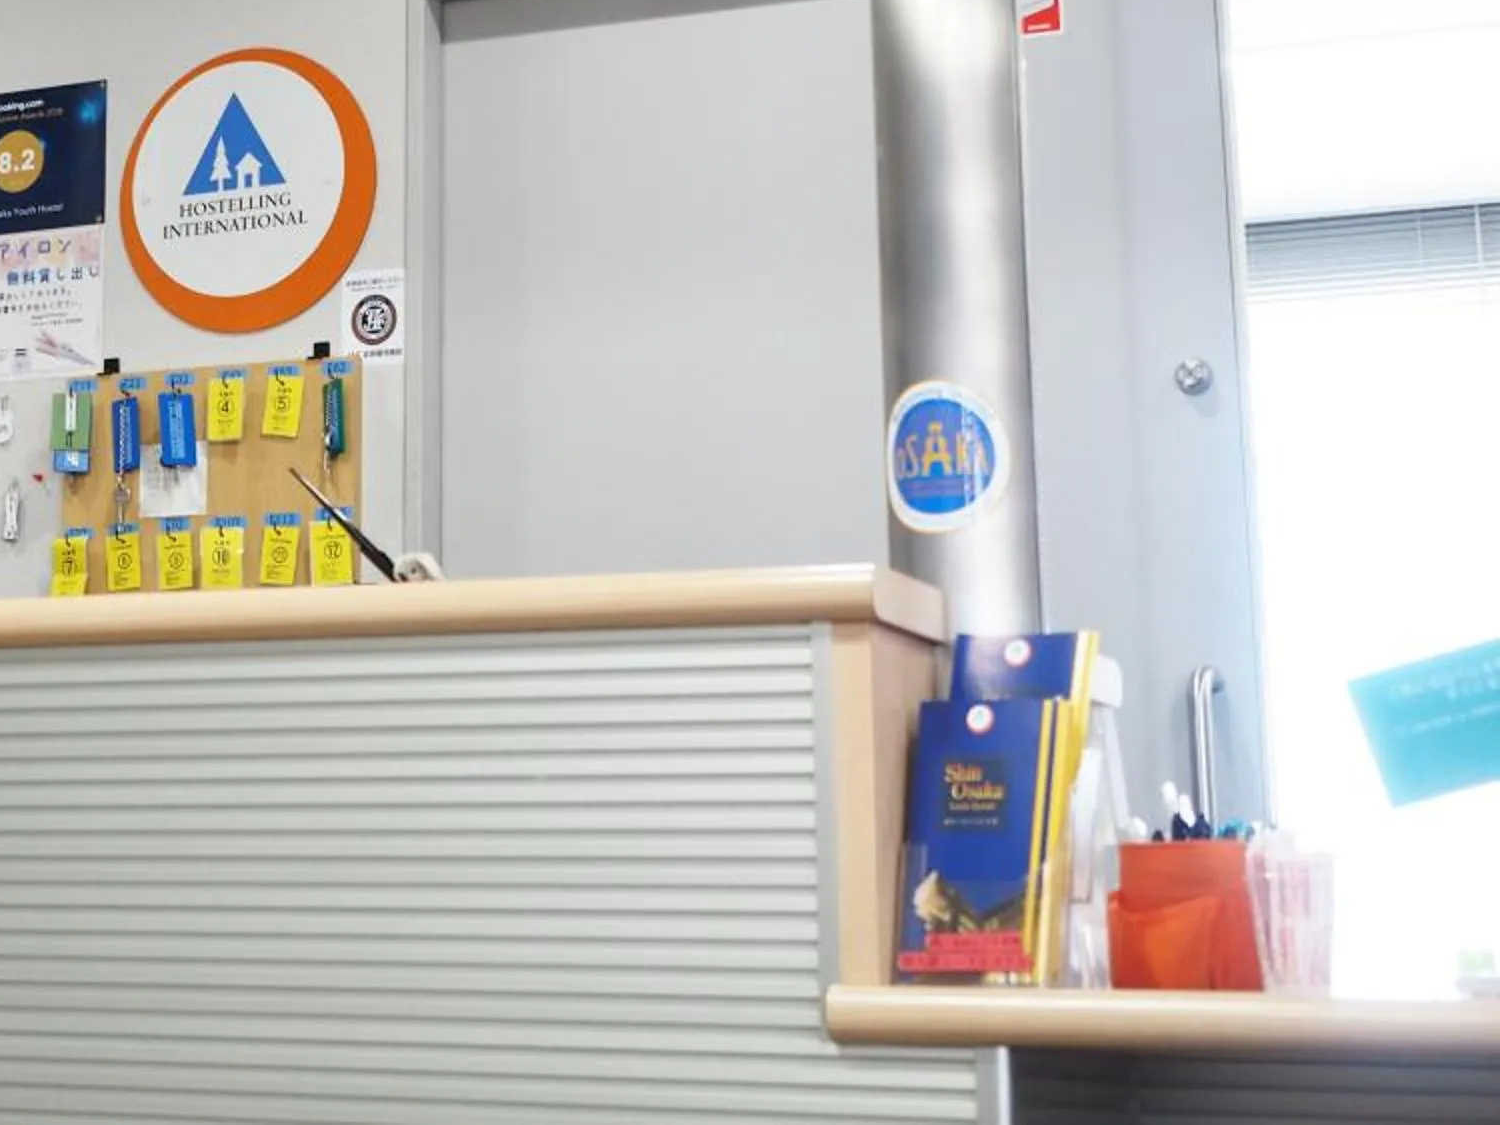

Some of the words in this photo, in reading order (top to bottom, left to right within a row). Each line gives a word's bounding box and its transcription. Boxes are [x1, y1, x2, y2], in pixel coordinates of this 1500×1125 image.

[179, 192, 291, 218] HOSTELLING
[163, 211, 308, 240] INTERNATIONAL
[7, 266, 99, 286] 無料貸し出し
